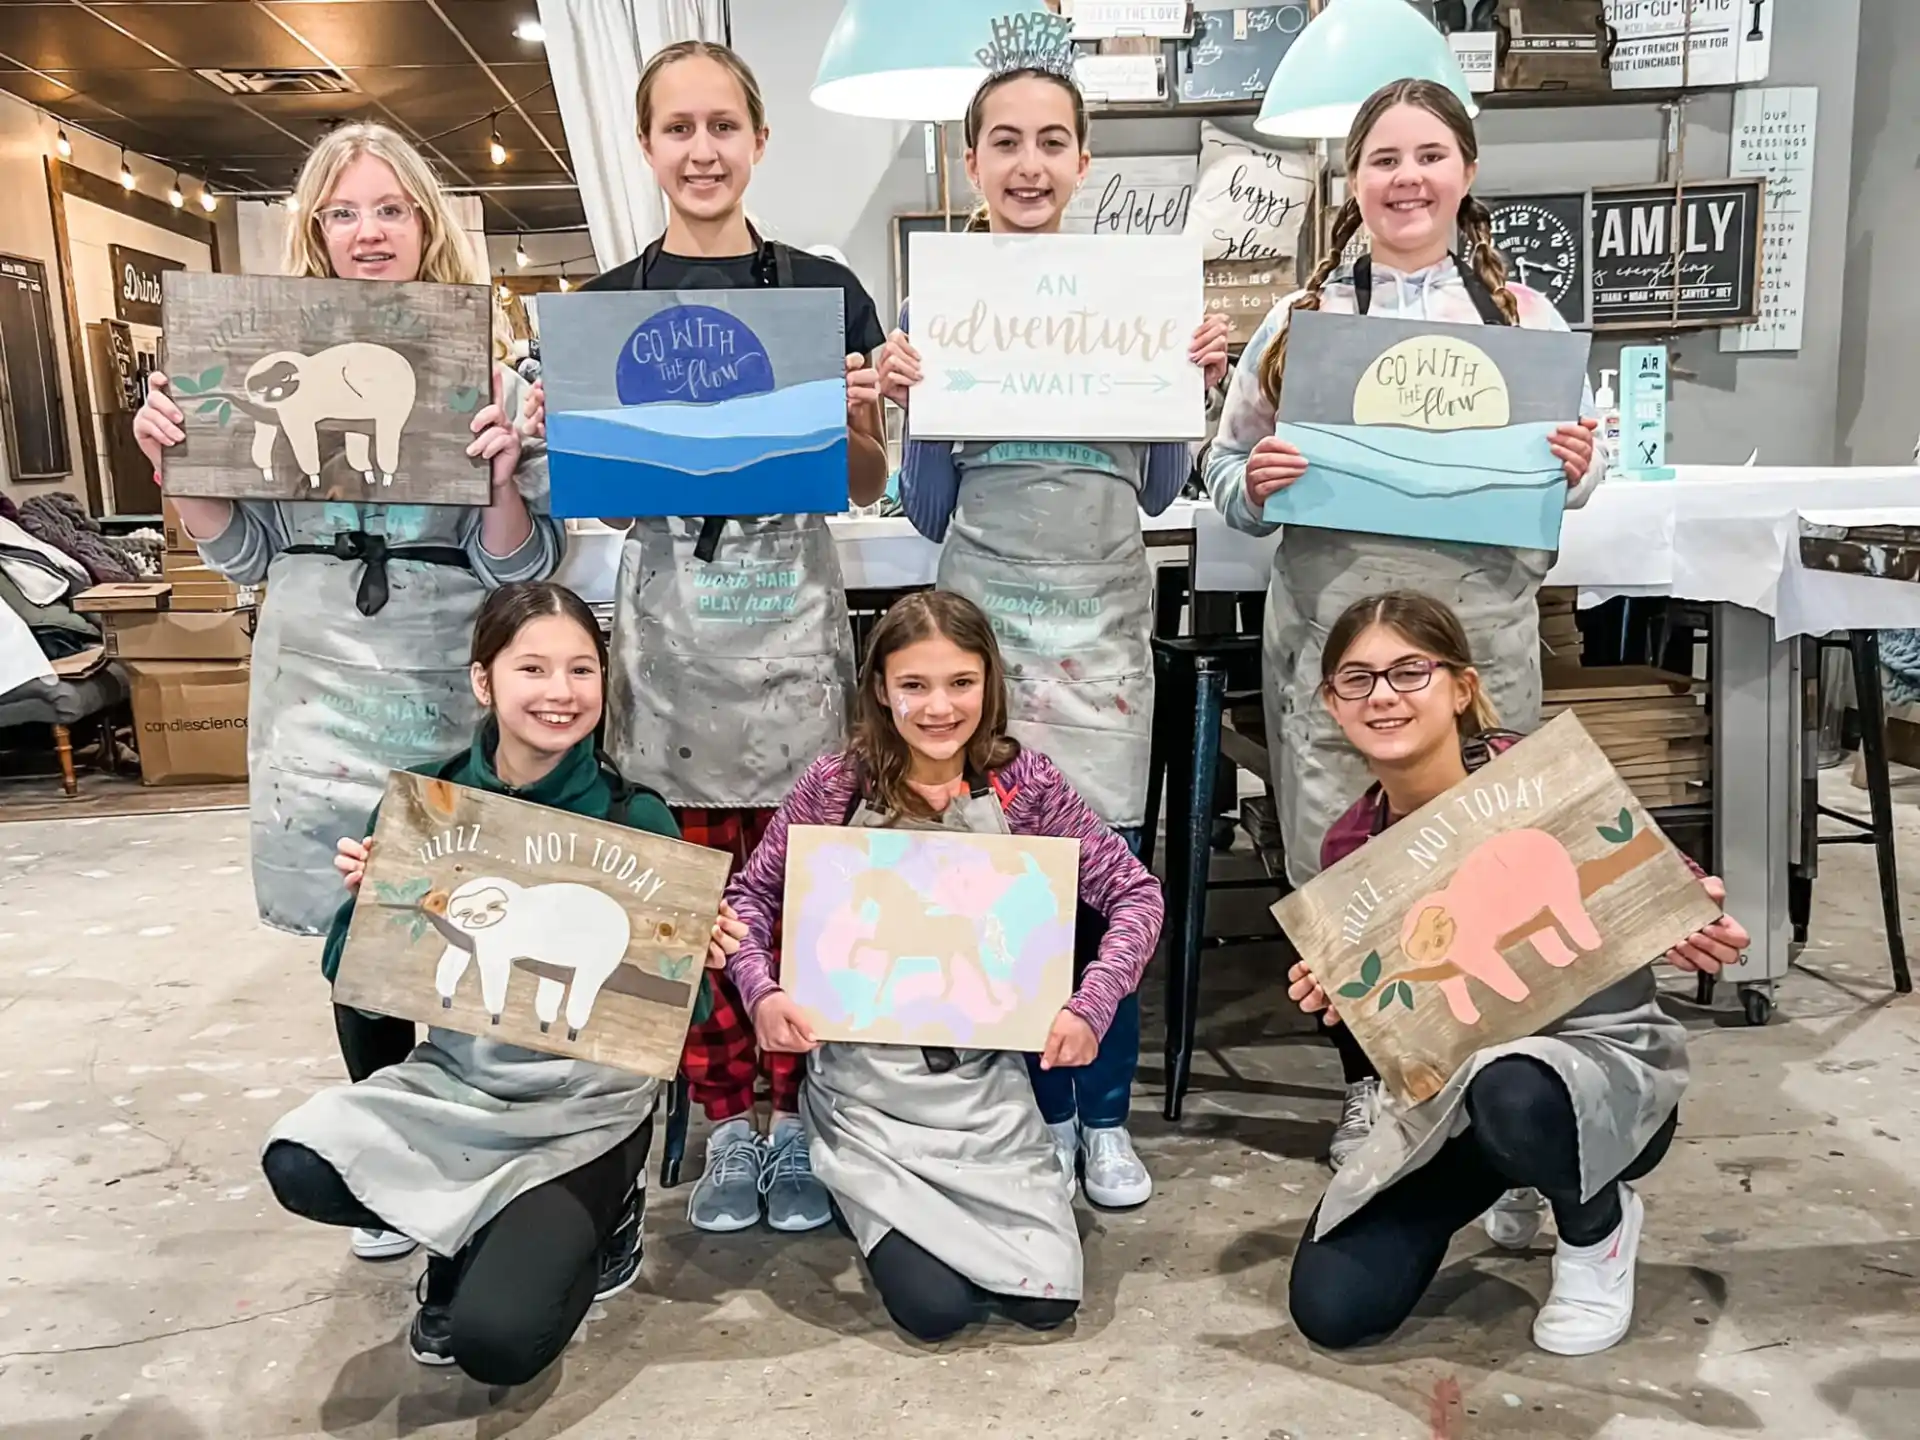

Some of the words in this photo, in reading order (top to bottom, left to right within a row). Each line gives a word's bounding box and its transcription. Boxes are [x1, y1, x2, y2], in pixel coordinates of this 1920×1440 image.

[1126, 6, 1148, 20] THE
[1150, 7, 1180, 20] LOVE
[990, 12, 1075, 40] HAPPY
[1614, 47, 1640, 58] ANCY
[1642, 42, 1679, 54] FRENCH
[1710, 37, 1729, 48] FOR
[1764, 111, 1787, 121] OUR
[1743, 124, 1806, 135] GREATEST
[1740, 138, 1807, 149] BLESSINGS
[1747, 152, 1778, 161] CALL
[1784, 151, 1799, 161] US
[1207, 164, 1306, 228] happy
[1509, 212, 1530, 226] 12
[1537, 218, 1547, 231] 1
[1212, 228, 1284, 260] place
[1550, 233, 1563, 247] 2
[1557, 253, 1569, 267] 3
[1615, 250, 1716, 288] everything
[1036, 275, 1077, 296] AN
[1204, 272, 1239, 285] ith
[1249, 273, 1272, 285] me
[1550, 274, 1563, 288] 4
[1241, 294, 1261, 308] to
[632, 329, 665, 364] GO
[669, 317, 735, 356] WITH
[928, 299, 1182, 362] adventure
[658, 358, 685, 381] THE
[666, 352, 761, 399] flow
[1376, 355, 1407, 386] GO
[1416, 348, 1480, 387] WITH
[1001, 373, 1112, 396] AWAITS
[1397, 384, 1422, 405] THE
[1401, 386, 1502, 425] flow
[694, 570, 750, 589] work
[756, 571, 799, 588] HARD
[700, 596, 741, 611] PLAY
[744, 594, 797, 614] hard
[525, 832, 578, 864] NOT
[1406, 811, 1459, 871] NOT
